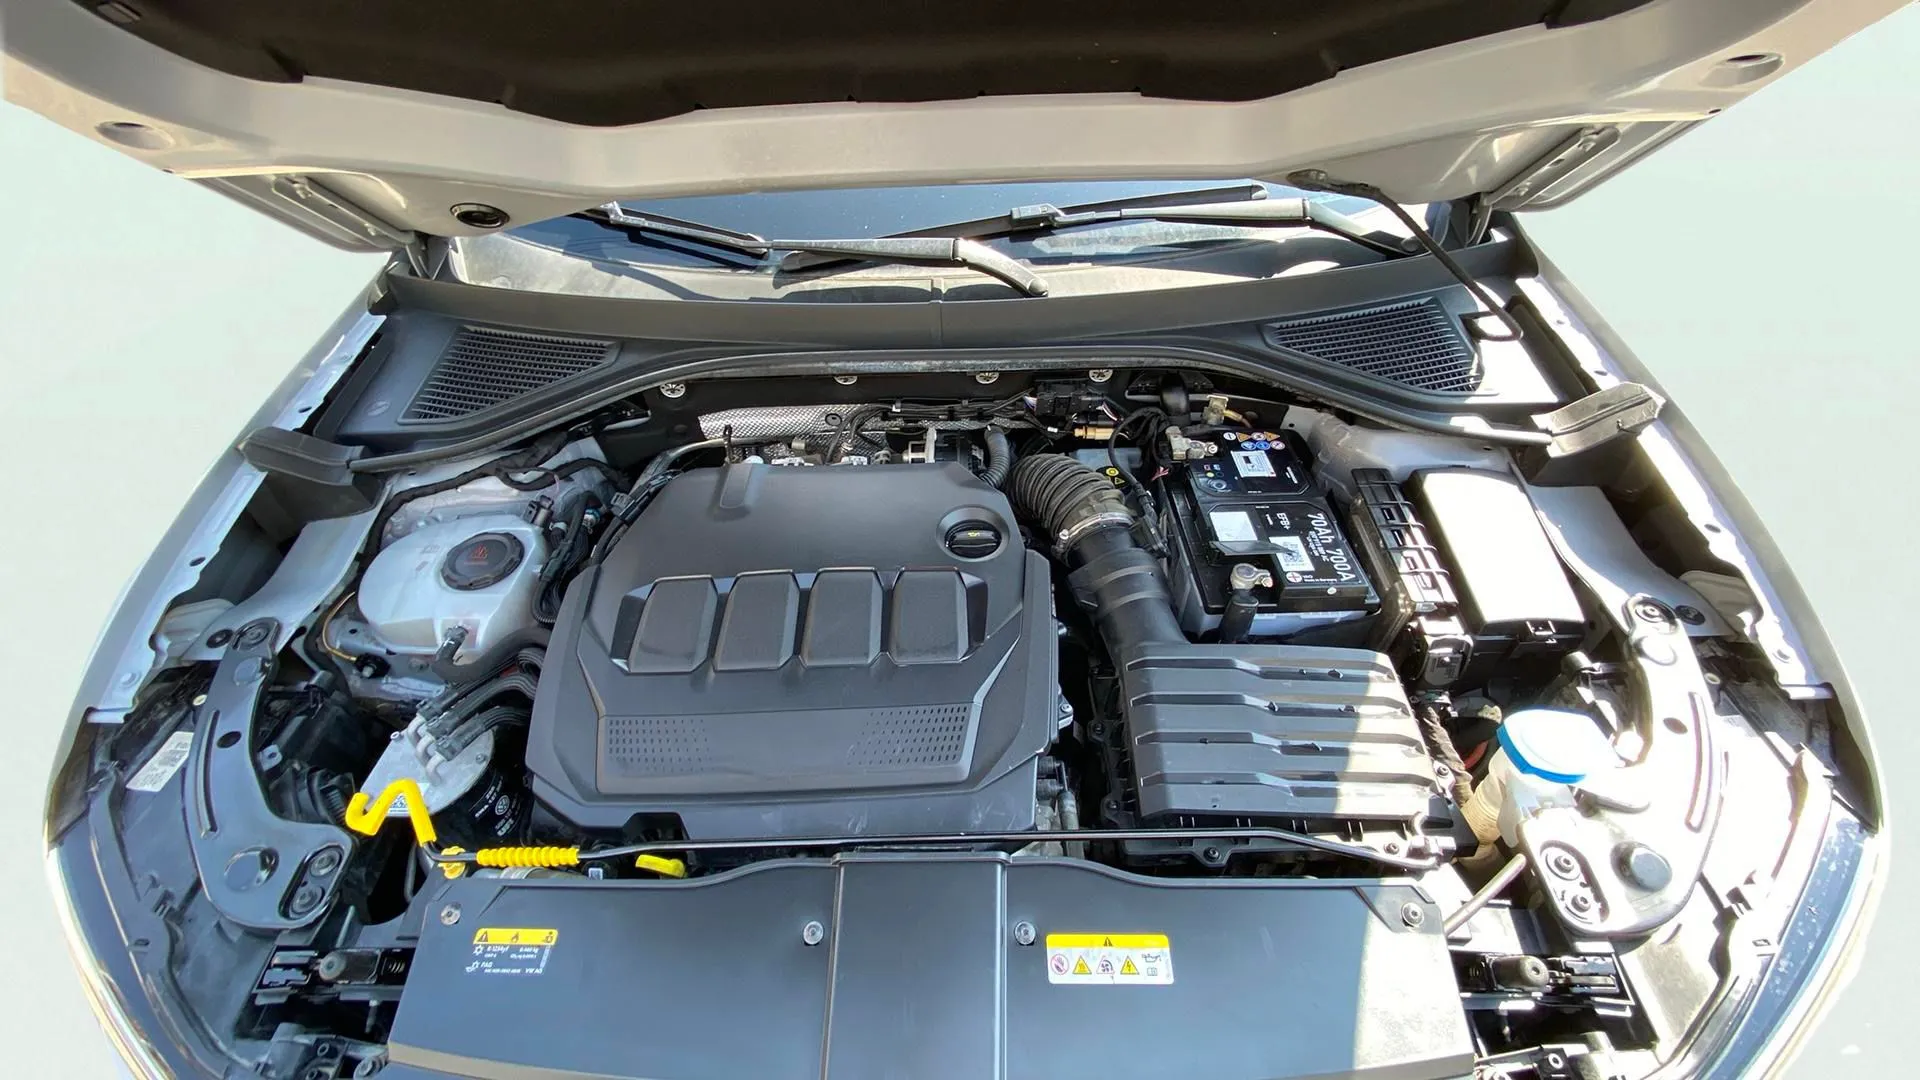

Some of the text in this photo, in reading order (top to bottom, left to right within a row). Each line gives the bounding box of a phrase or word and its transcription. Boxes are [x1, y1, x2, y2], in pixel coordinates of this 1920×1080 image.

[1276, 512, 1291, 530] EFB+
[1307, 513, 1335, 543] 70Ah
[1326, 548, 1356, 582] 700A
